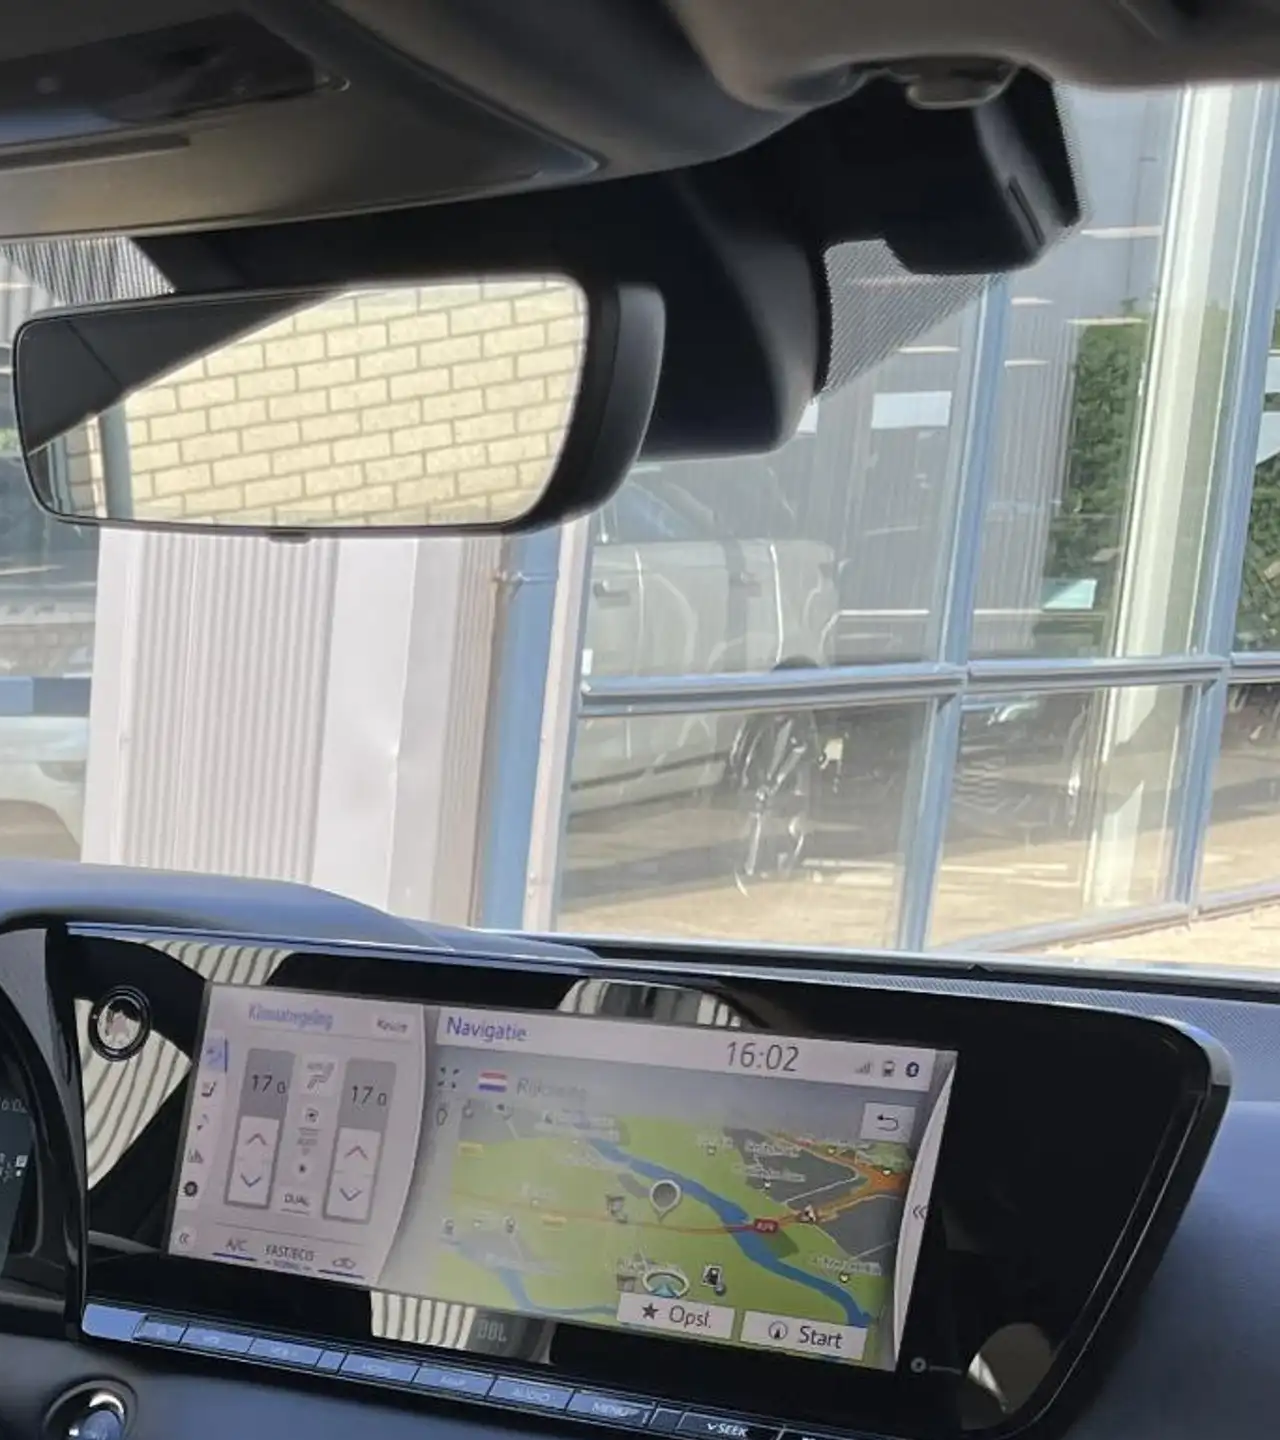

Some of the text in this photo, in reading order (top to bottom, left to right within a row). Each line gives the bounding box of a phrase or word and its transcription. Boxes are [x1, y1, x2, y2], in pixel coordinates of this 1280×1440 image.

[446, 1016, 528, 1042] Navigatie
[726, 1041, 800, 1072] 16:02
[224, 1238, 249, 1252] A/C
[798, 1325, 844, 1350] Start
[718, 1423, 749, 1439] SEEK
